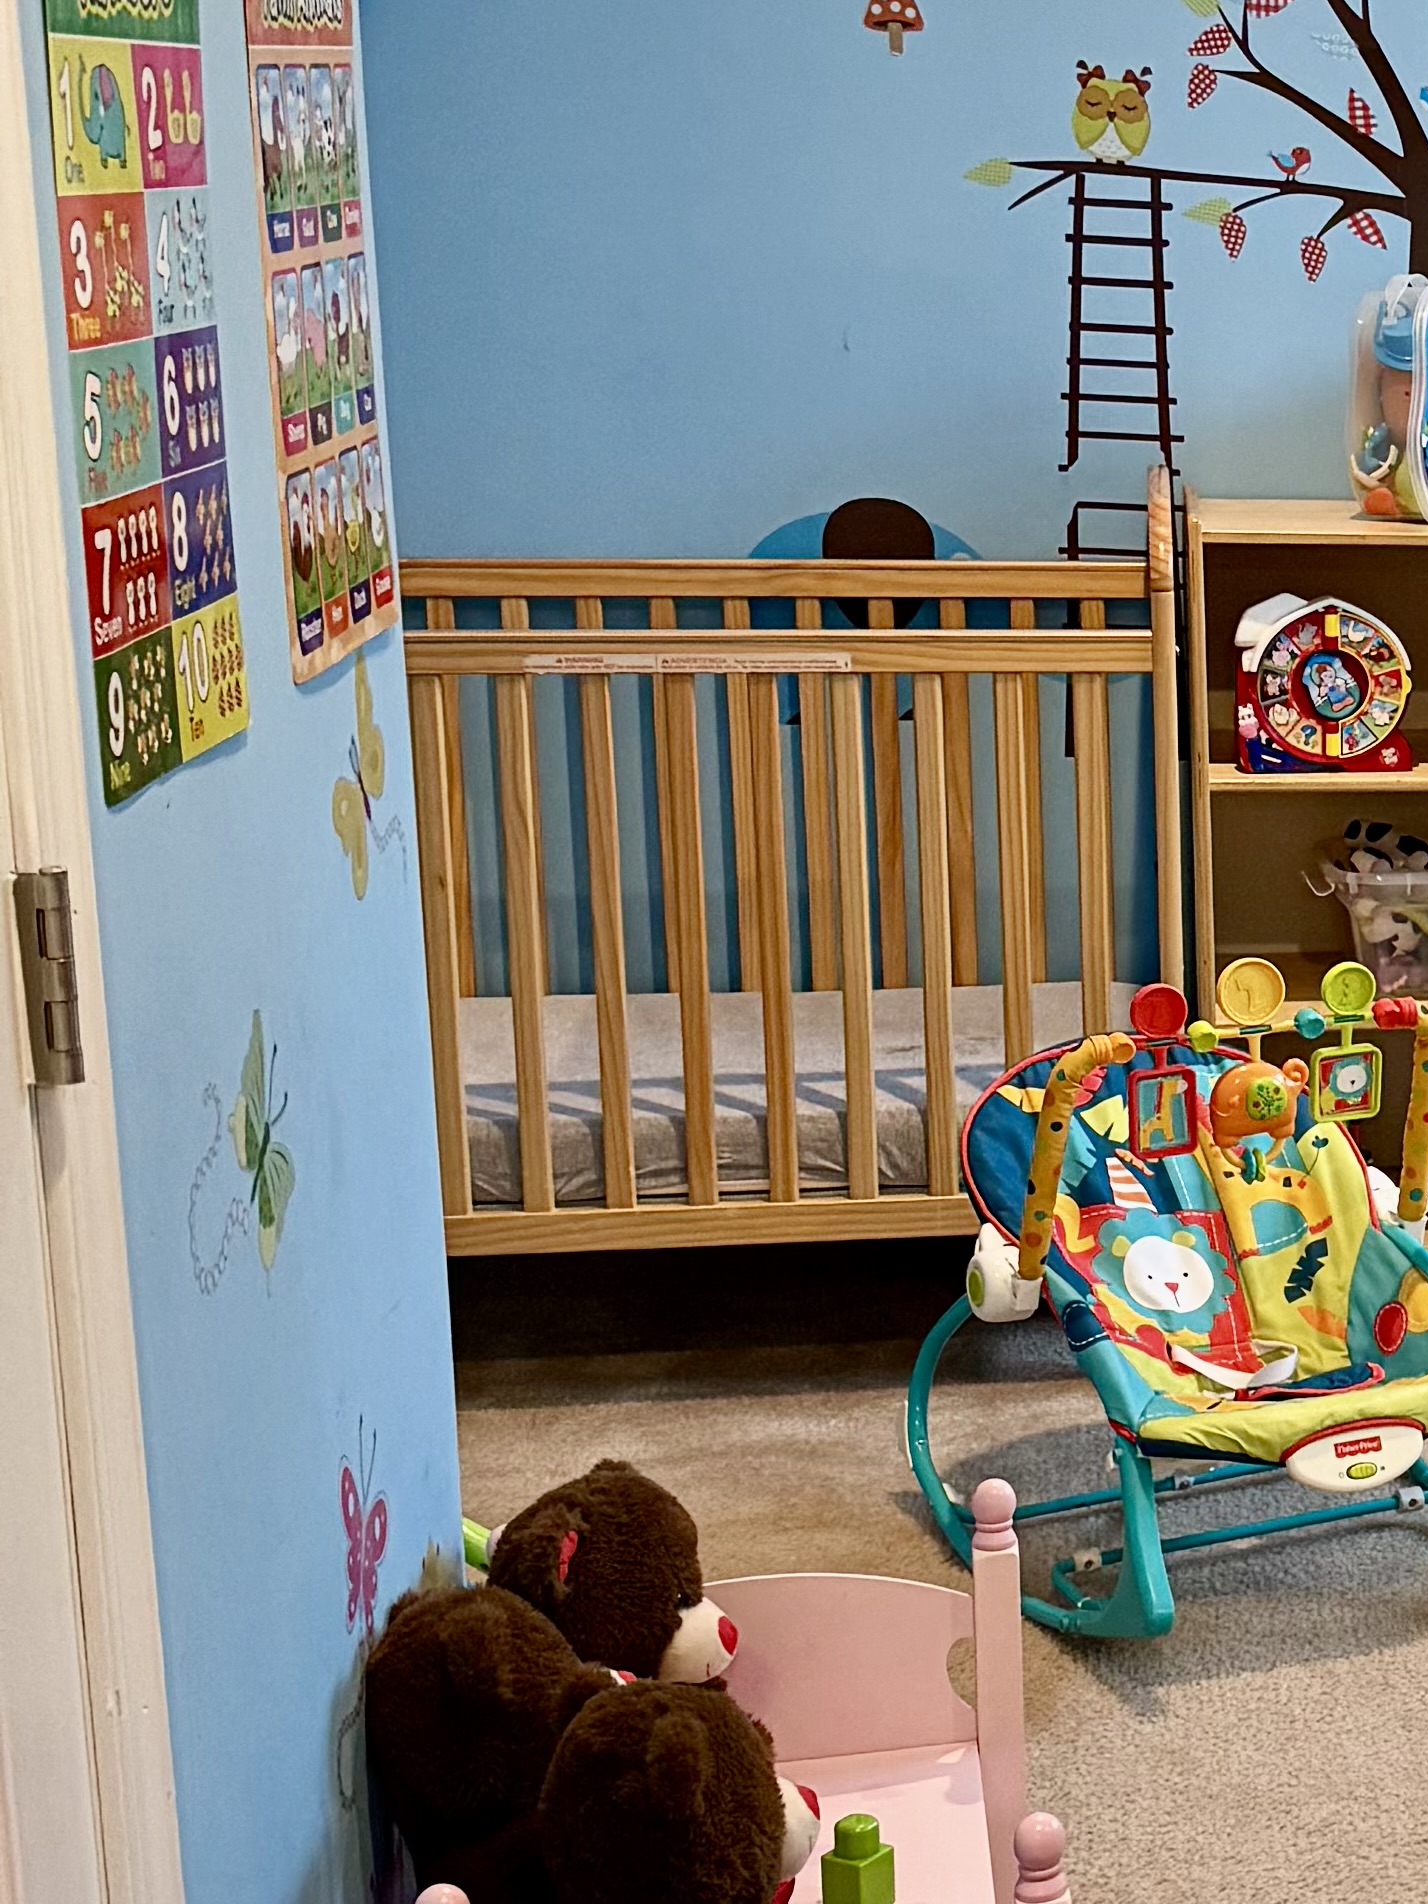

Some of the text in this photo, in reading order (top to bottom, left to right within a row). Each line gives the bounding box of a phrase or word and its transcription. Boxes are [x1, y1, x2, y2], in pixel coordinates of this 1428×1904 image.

[59, 56, 74, 151] 1
[142, 66, 163, 150] 2
[69, 218, 93, 310] 3
[156, 211, 171, 297] 4
[70, 311, 102, 342] Three
[83, 370, 102, 463] 5
[163, 353, 180, 437] 6
[94, 528, 113, 616] 7
[172, 490, 189, 573] 8
[94, 615, 124, 646] Seven
[178, 620, 209, 714] 10
[108, 671, 125, 758] 9
